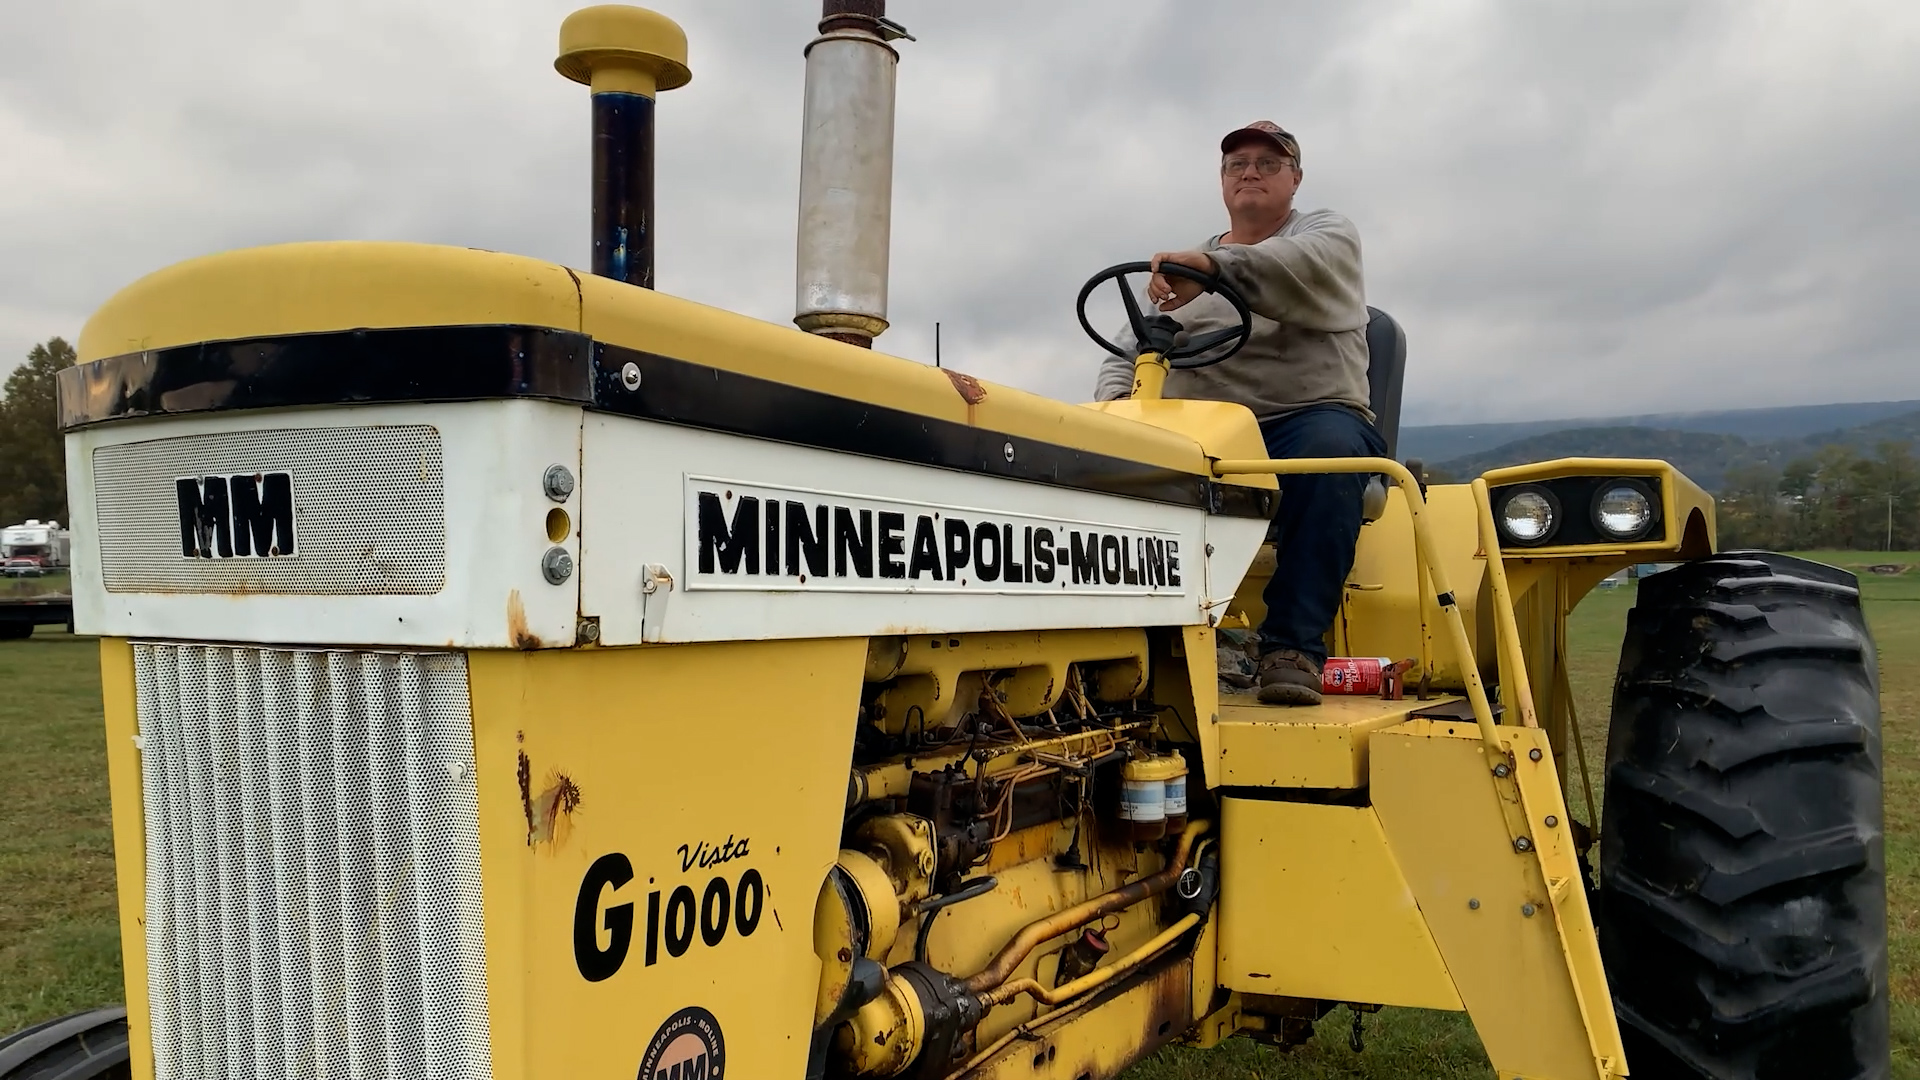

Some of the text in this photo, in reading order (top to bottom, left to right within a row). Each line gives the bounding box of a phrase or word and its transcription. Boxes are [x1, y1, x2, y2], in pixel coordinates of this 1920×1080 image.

[176, 473, 294, 558] MM
[698, 491, 1181, 587] MINNEAPOLIS-MOLINE
[1344, 668, 1353, 692] BRAKE
[1348, 661, 1359, 682] FLUID
[677, 834, 749, 872] Vista
[698, 1019, 719, 1057] MOLINE
